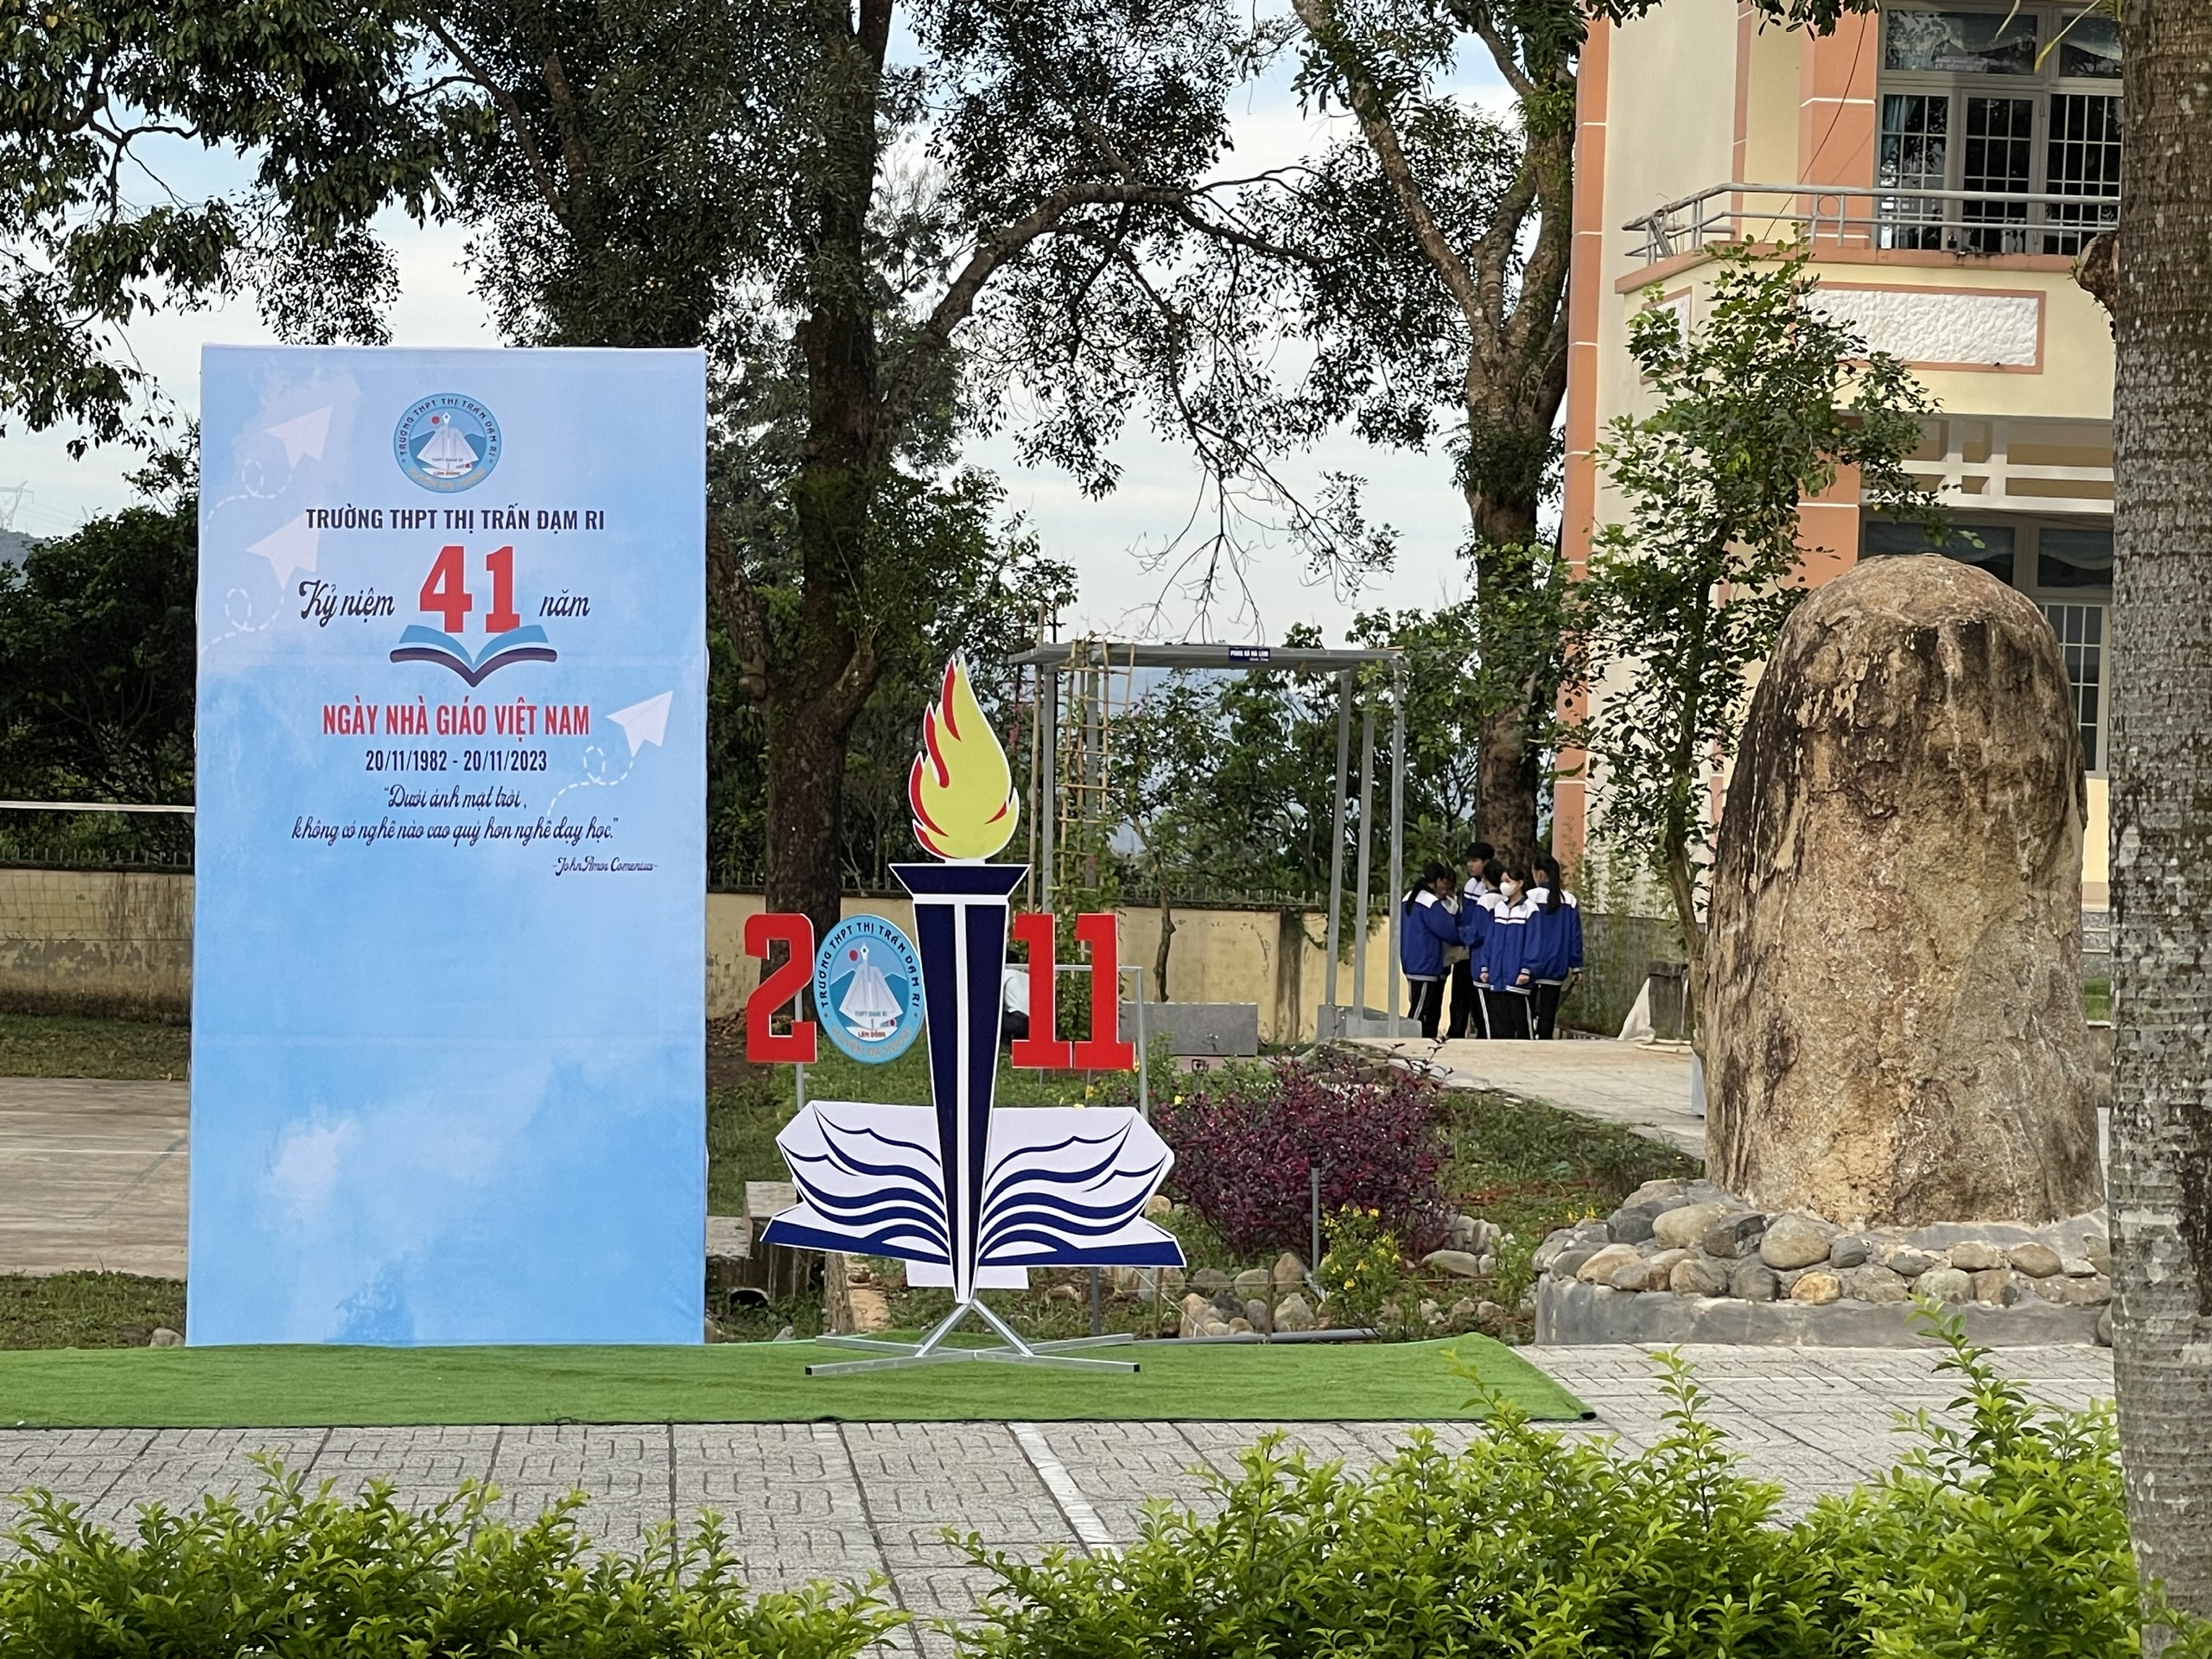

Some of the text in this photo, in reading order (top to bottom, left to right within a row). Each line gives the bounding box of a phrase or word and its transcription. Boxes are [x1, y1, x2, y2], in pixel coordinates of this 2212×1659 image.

[413, 399, 436, 416] THPT
[489, 446, 497, 456] RI
[306, 503, 604, 534] TRƯỜNG THPT THỊ TRẤN ĐẠM RI
[299, 546, 591, 633] Kỷ niệm 41 năm
[323, 696, 589, 742] NGÀY NHÀ GIÁO VIỆT NAM
[365, 750, 448, 772] 20/11/1982
[463, 750, 547, 772] 20/11/2023
[429, 785, 460, 808] ánh
[291, 816, 340, 847] không
[342, 820, 356, 839] có
[397, 819, 424, 839] nào
[428, 825, 450, 839] cao
[452, 821, 480, 847] quý
[553, 816, 583, 847] dạy
[581, 855, 608, 872] Amos
[830, 925, 852, 949] THPT
[856, 923, 874, 934] THỊ
[912, 994, 920, 1007] RI
